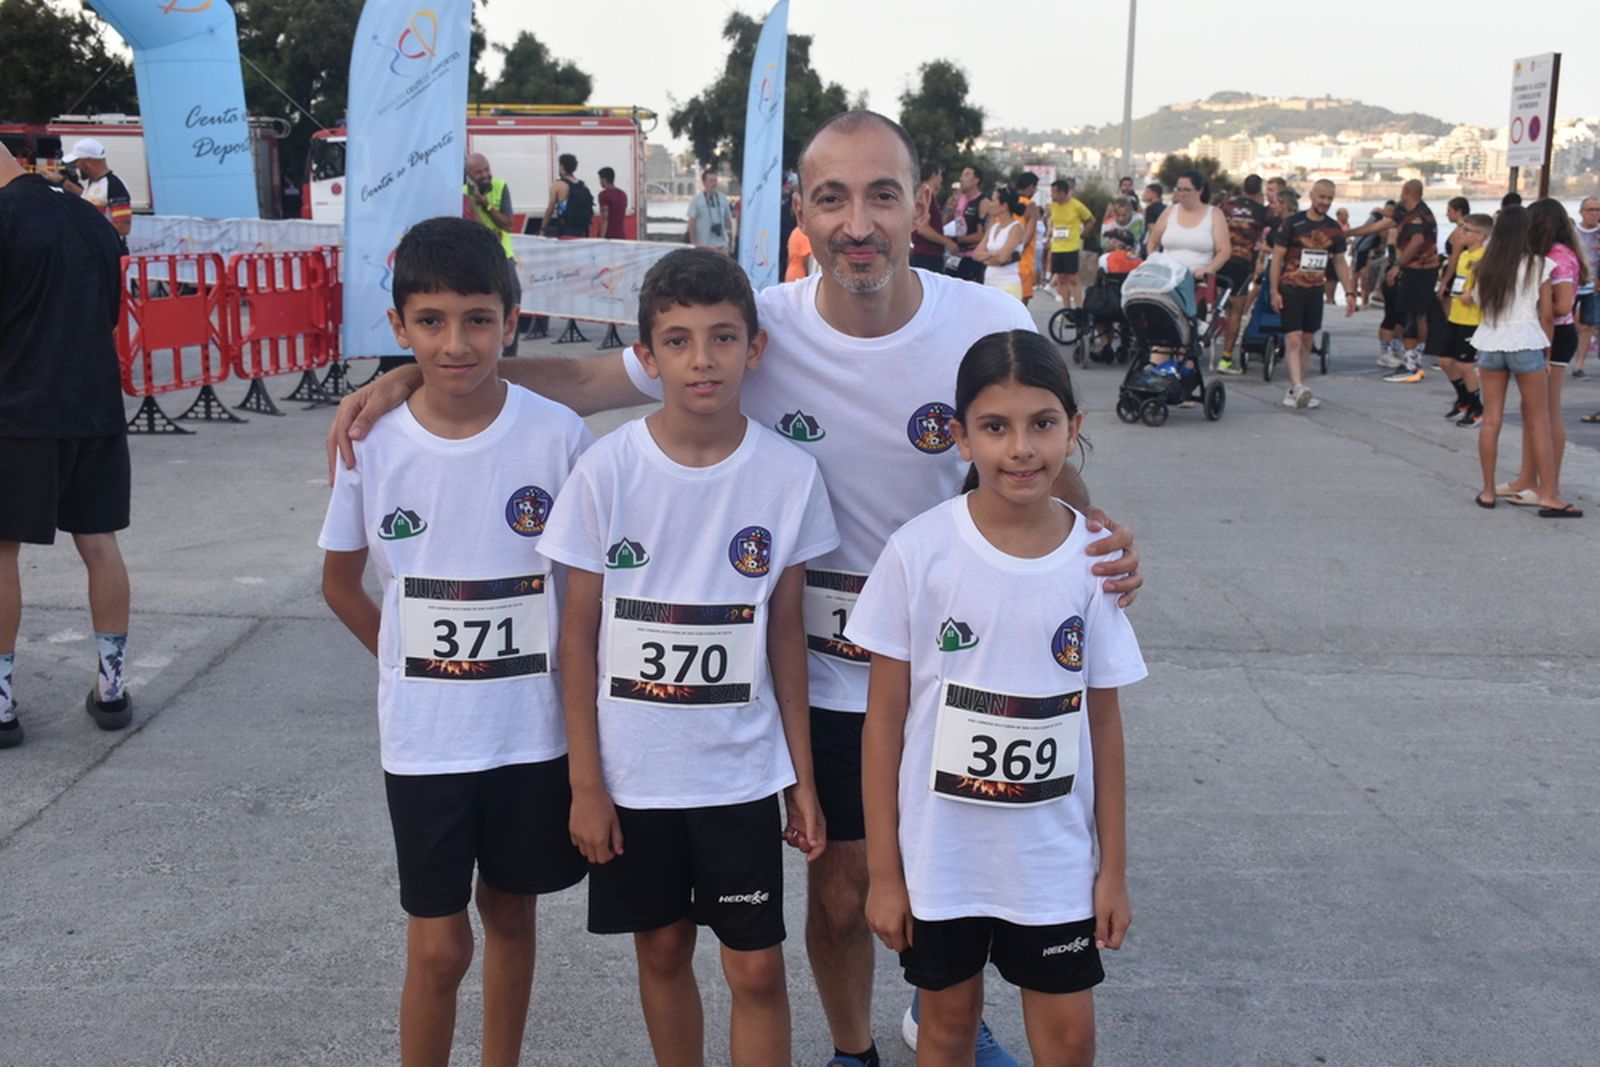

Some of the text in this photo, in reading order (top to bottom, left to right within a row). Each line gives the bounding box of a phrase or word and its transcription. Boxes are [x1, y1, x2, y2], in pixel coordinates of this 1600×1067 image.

[615, 598, 673, 624] JUAN
[433, 617, 520, 659] 371
[640, 641, 728, 684] 370
[946, 684, 1009, 717] JUAN
[967, 734, 1057, 781] 369
